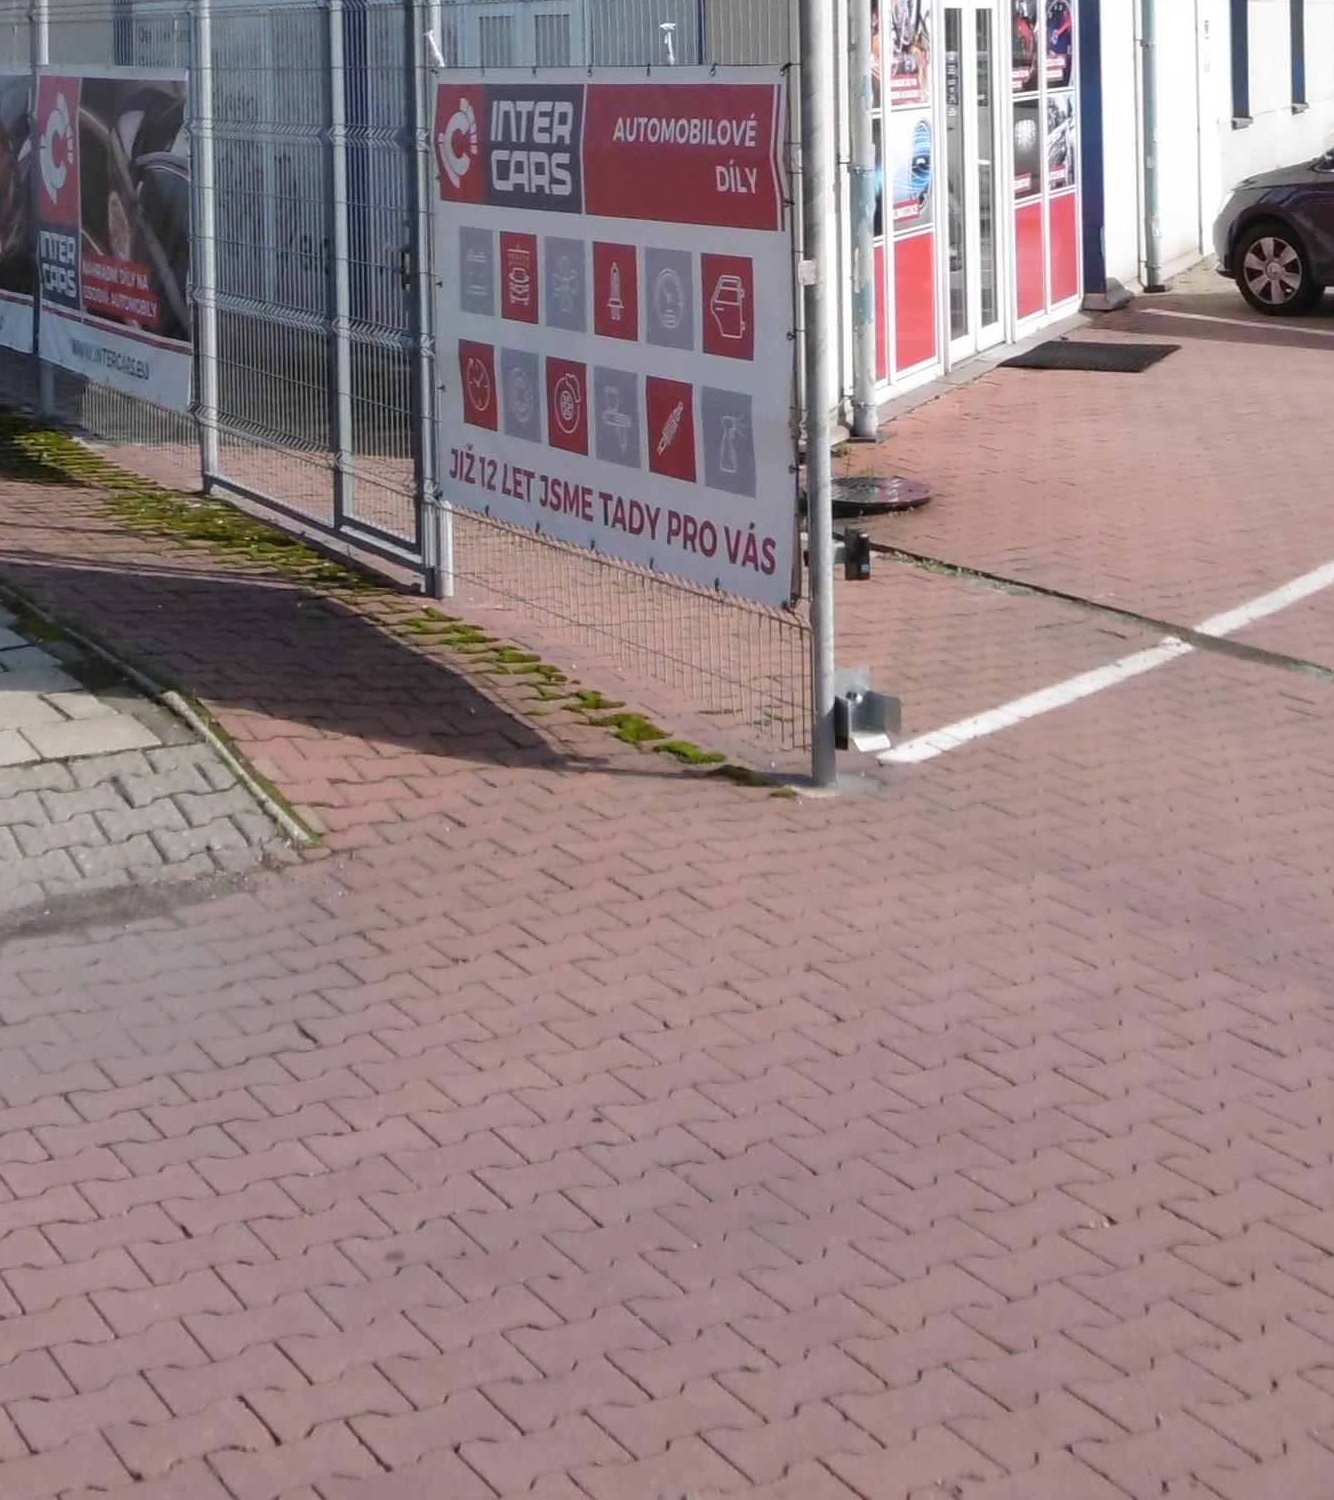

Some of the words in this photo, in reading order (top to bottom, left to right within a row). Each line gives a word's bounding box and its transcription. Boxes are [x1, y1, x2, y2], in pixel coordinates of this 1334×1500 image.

[489, 99, 574, 145] INTER
[613, 113, 758, 149] AUTOMOBILOVÉ
[490, 149, 573, 196] CARS
[715, 160, 759, 195] DÍLY
[40, 229, 77, 265] INTER
[41, 263, 77, 299] CARS
[70, 338, 150, 381] WWW.INTERCARS.EU
[449, 444, 476, 486] JIŽ
[478, 456, 498, 492] 12
[501, 461, 536, 504] LET
[538, 473, 595, 526] JSME
[598, 492, 662, 540] TADY
[667, 508, 718, 559] PRO
[724, 522, 777, 576] VÁS
